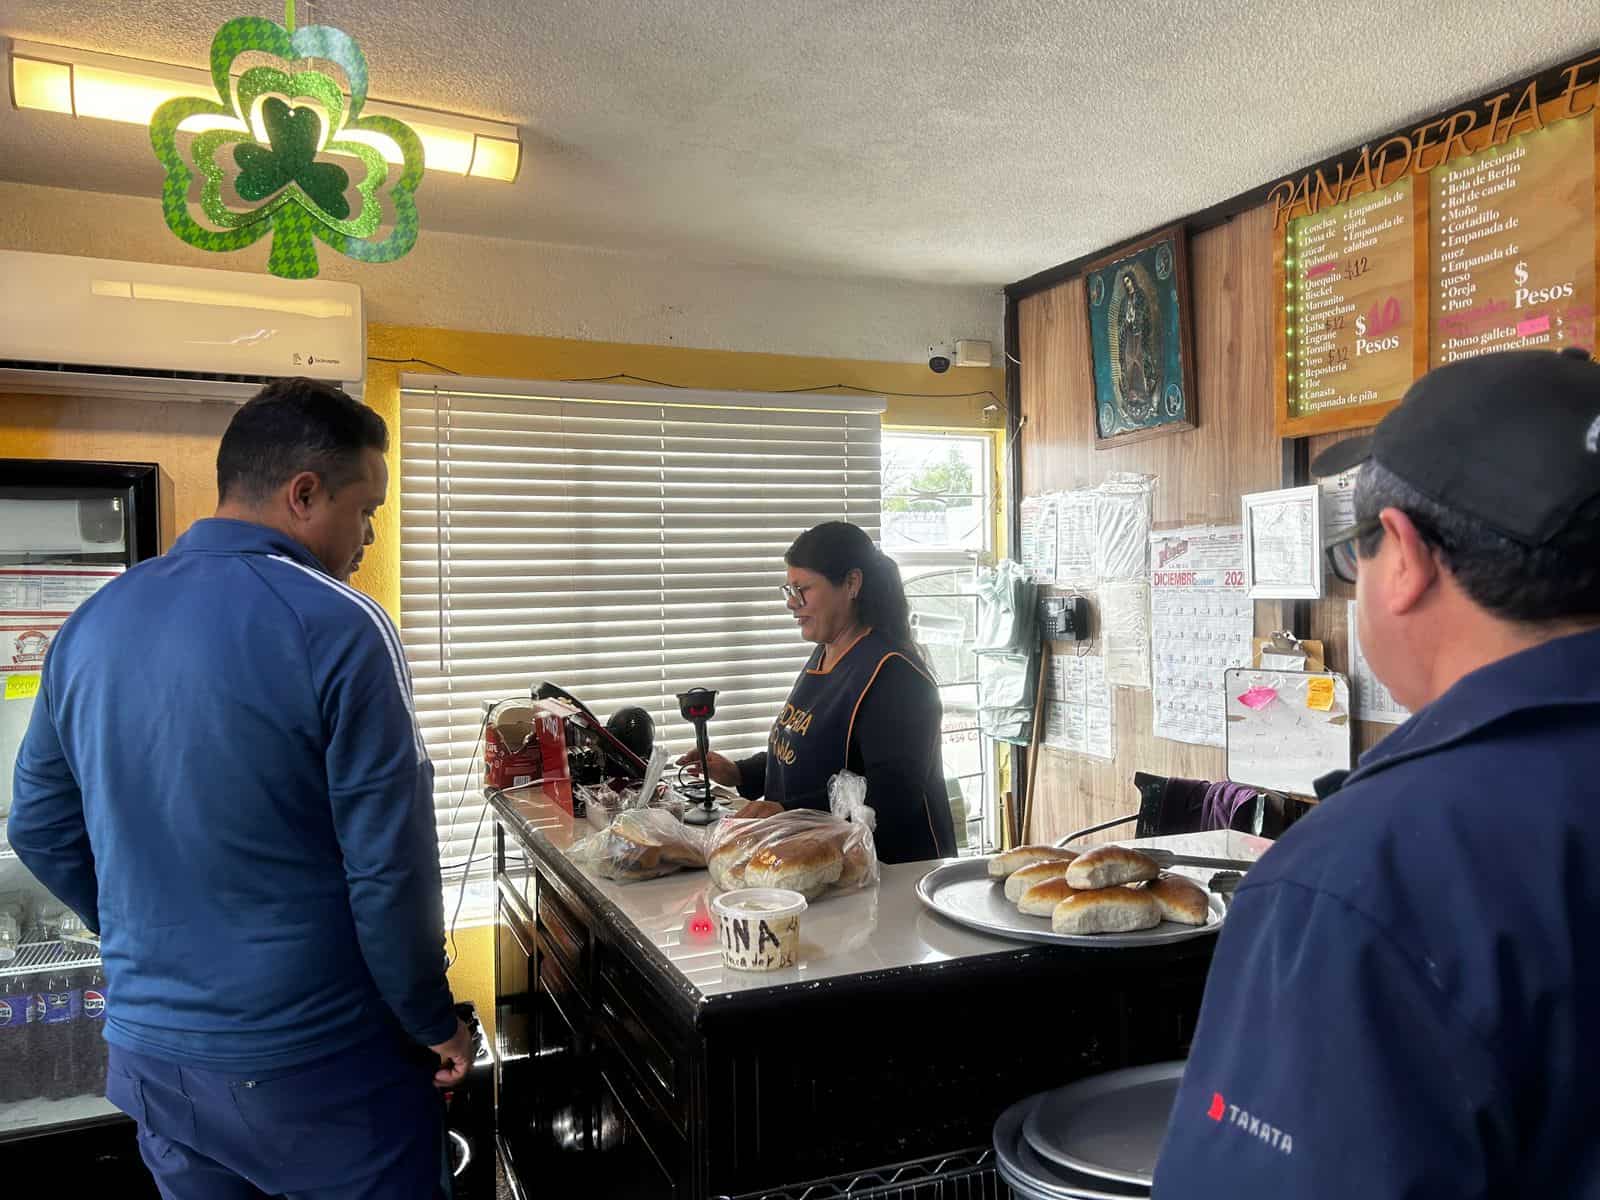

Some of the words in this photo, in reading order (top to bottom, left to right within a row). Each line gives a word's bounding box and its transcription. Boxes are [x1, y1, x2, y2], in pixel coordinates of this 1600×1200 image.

[1266, 79, 1545, 231] PANADERIA
[1560, 56, 1600, 120] E
[1449, 167, 1475, 182] Dona
[1477, 147, 1526, 171] decorada
[1449, 180, 1471, 195] Bola
[1473, 175, 1485, 186] de
[1488, 163, 1521, 181] Berlín
[1449, 192, 1465, 208] Rol
[1467, 190, 1480, 202] de
[1482, 178, 1516, 196] canela
[1349, 195, 1392, 219] Empanada
[1393, 191, 1404, 202] de
[1448, 205, 1477, 219] Moño
[1304, 217, 1337, 235] Conchas
[1343, 218, 1366, 233] cajeta
[1349, 220, 1392, 241] Empanada
[1393, 215, 1405, 226] de
[1448, 209, 1500, 233] Cortadillo
[1449, 222, 1503, 247] Empanada
[1505, 216, 1518, 230] de
[1326, 228, 1336, 239] de
[1343, 237, 1378, 255] calabaza
[1441, 248, 1465, 262] nuez
[1449, 248, 1503, 272] Empanada
[1505, 244, 1518, 257] de
[1305, 273, 1341, 291] Quequito
[1440, 272, 1471, 288] queso
[1514, 260, 1529, 287] $
[1448, 282, 1476, 298] Oreja
[1514, 281, 1574, 309] Pesos
[1305, 295, 1345, 312] Marranito
[1305, 303, 1356, 322] Campechana
[1448, 297, 1473, 311] Puro
[1304, 321, 1325, 336] Jaiba
[1354, 314, 1366, 336] $
[1356, 335, 1400, 356] Pesos
[1449, 335, 1479, 349] Domo
[1480, 326, 1517, 345] galleta
[1448, 347, 1479, 363] Domo
[1480, 334, 1550, 354] campechana
[1304, 387, 1336, 400] Canasta
[1305, 379, 1321, 390] Flor
[1304, 395, 1346, 411] Empanada
[1347, 393, 1358, 403] de
[1359, 390, 1378, 405] piña
[1154, 572, 1197, 586] DICIEMBRE
[1224, 571, 1245, 587] 202
[1229, 1104, 1293, 1155] TAKATA
